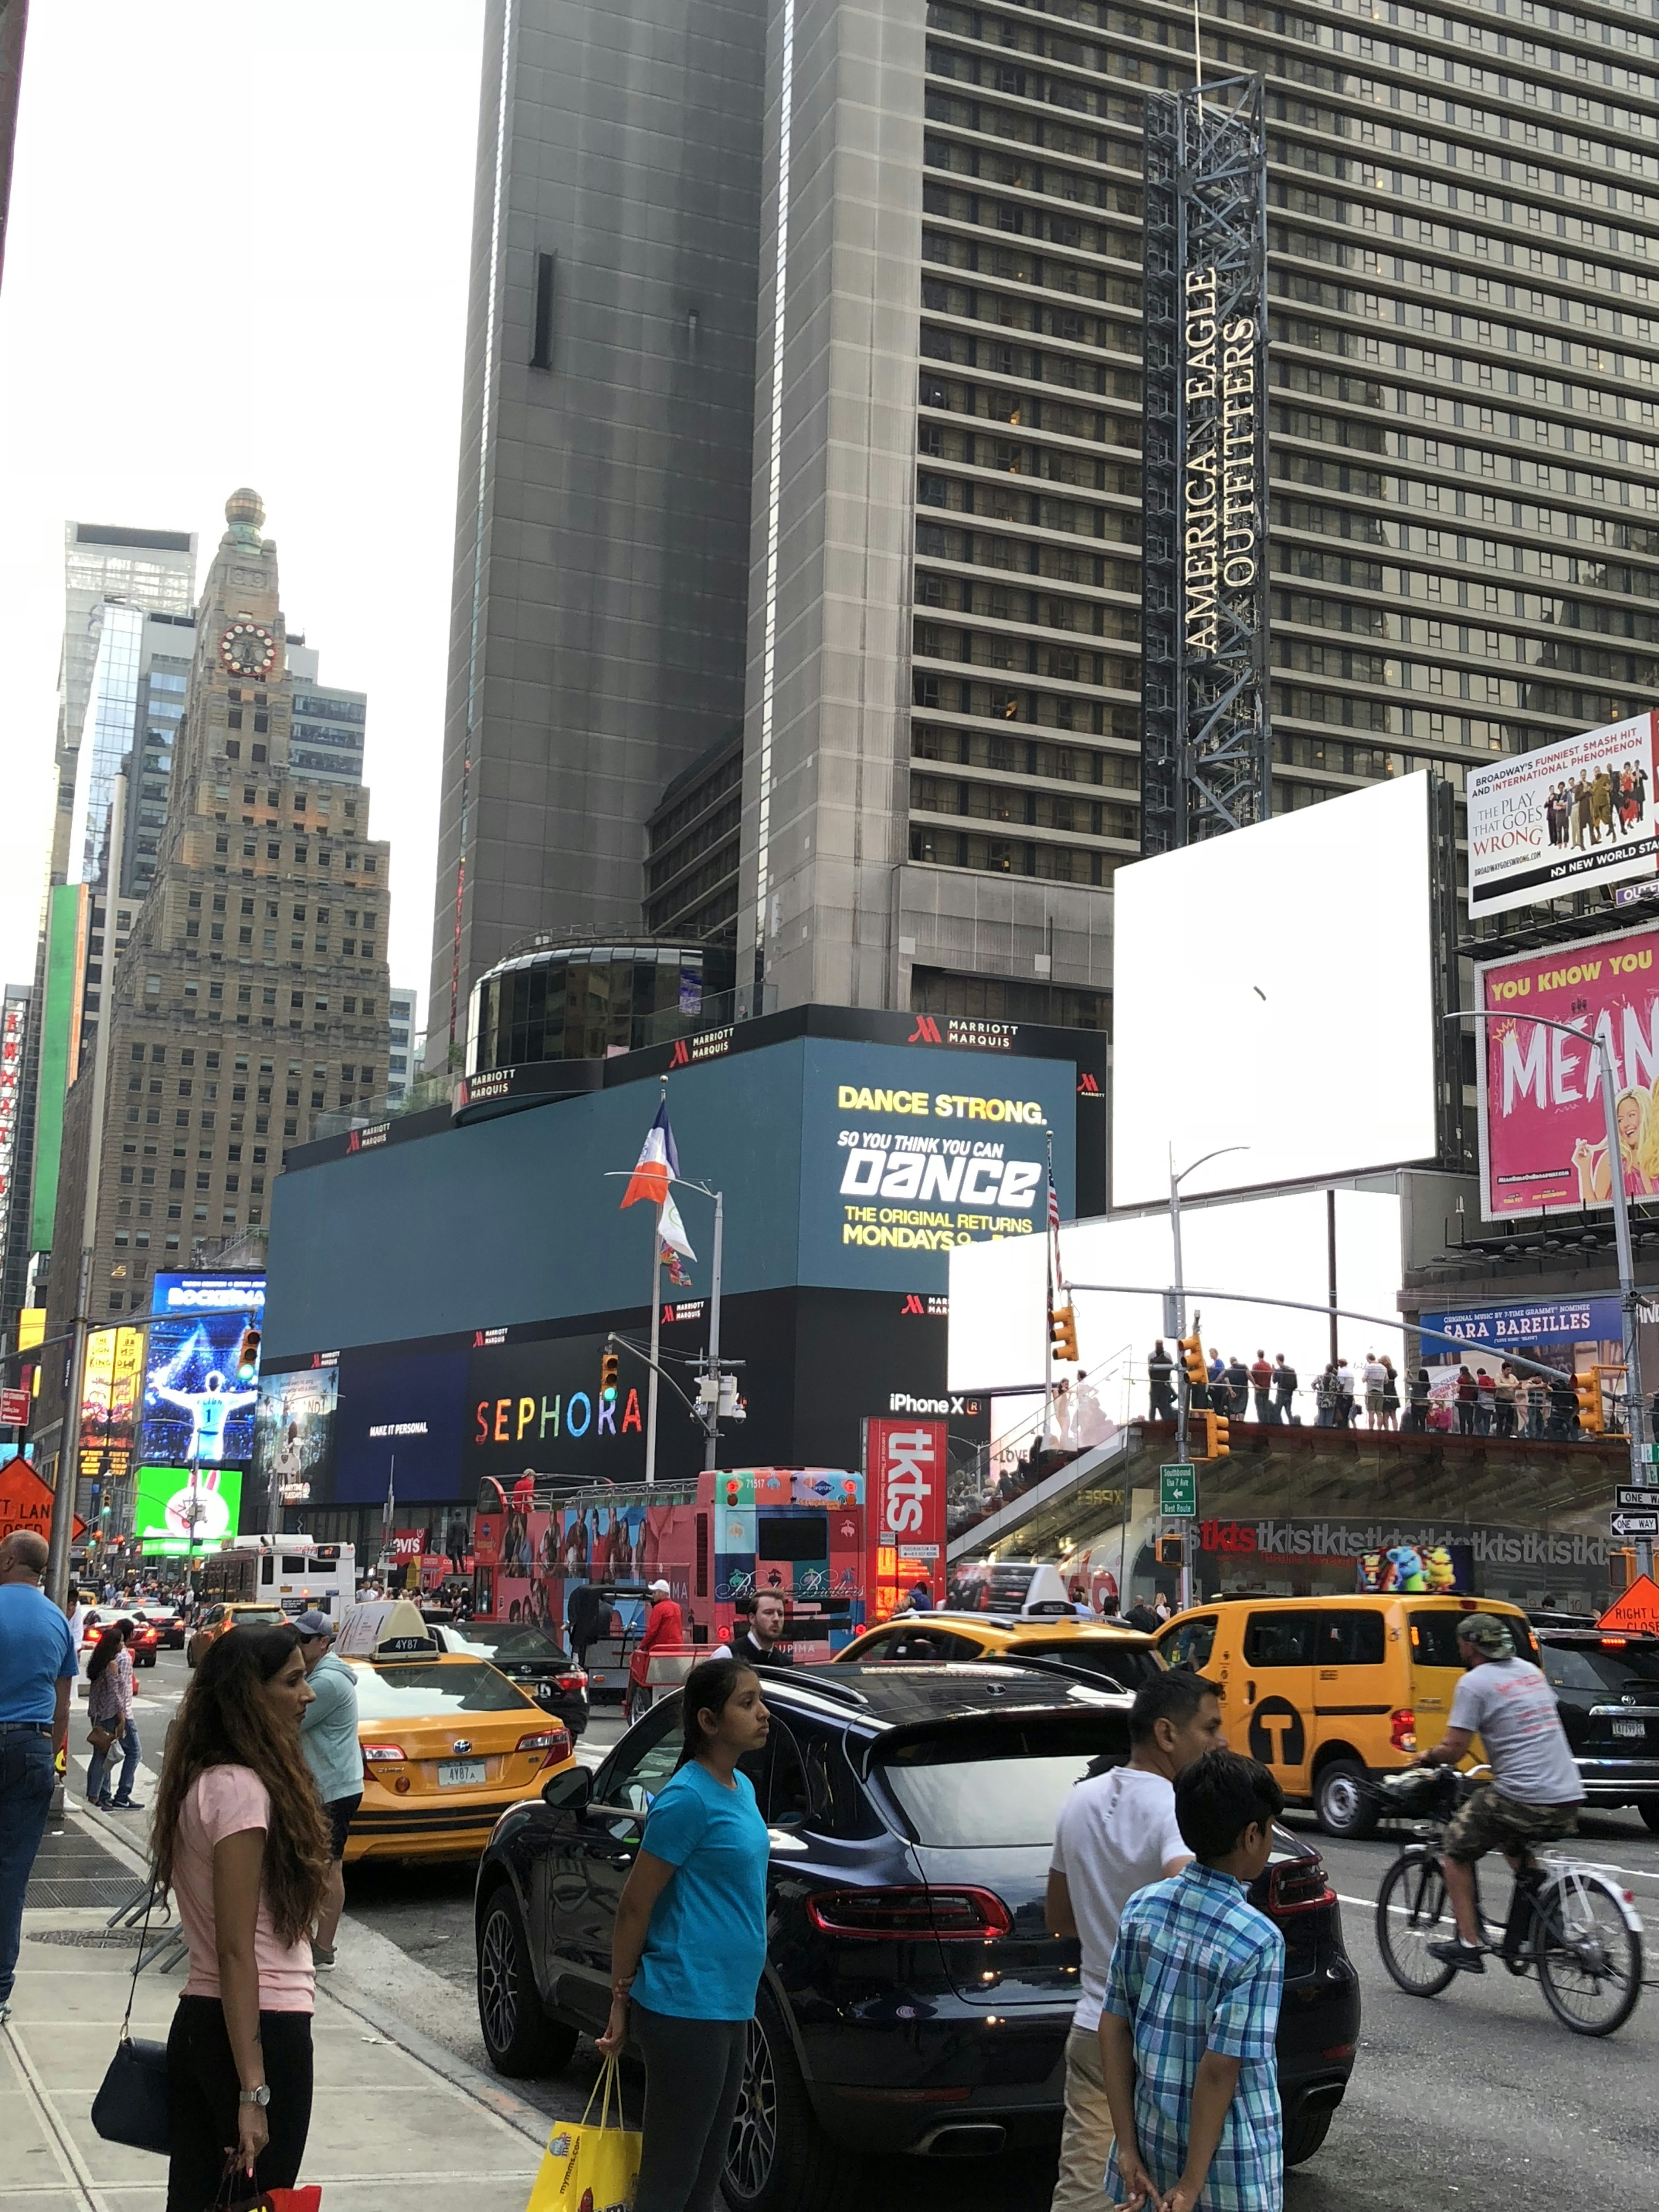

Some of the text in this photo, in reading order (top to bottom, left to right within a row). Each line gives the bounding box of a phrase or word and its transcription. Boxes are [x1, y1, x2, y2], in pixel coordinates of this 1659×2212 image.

[1184, 267, 1217, 653] AMERICAN EAGLE
[1224, 318, 1255, 588] OUTFITTERS
[1475, 727, 1637, 786] BROADWAY'S FUNNIEST SMASH HIT
[1472, 737, 1643, 798] AND INTERNATIONAL PHENOMENON
[1478, 790, 1535, 821] THE PLAY
[1473, 804, 1543, 836] THAT GOES
[1472, 826, 1543, 857] WRONG
[1569, 859, 1593, 873] NEW
[1596, 849, 1636, 867] WORLD
[1491, 950, 1653, 1001] YOU KNOW YOU
[693, 1027, 734, 1047] MARRIOTT
[950, 1020, 1018, 1034] MARRIOTT
[692, 1041, 728, 1059] MARQUIS
[950, 1034, 1010, 1047] MARQUIS
[1502, 997, 1659, 1118] MEAN
[471, 1068, 516, 1086] MARRIOTT
[471, 1083, 509, 1099] MARQUIS
[838, 1086, 1047, 1125] DANCE STRONG.
[362, 1123, 391, 1136] MARRIOTT
[361, 1133, 387, 1147] MARQUIS
[837, 1130, 1004, 1158] SO YOU THINK YOU CAN
[845, 1205, 1033, 1234] THE ORIGINAL RETURNS
[843, 1224, 955, 1251] MONDAYS
[676, 1301, 704, 1311] MARRIOTT
[676, 1309, 701, 1320] MARQUIS
[1443, 1316, 1473, 1324] ORIGINAL
[1474, 1313, 1494, 1321] MUSIC
[1504, 1309, 1524, 1318] 7-TIME
[1560, 1304, 1591, 1312] NOMINEE
[485, 1328, 508, 1336] MARRIOTT
[1443, 1313, 1591, 1338] SARA BAREILLES
[484, 1335, 505, 1344] MARQUIS
[890, 1393, 949, 1414] iPhone
[950, 1396, 965, 1415] X
[476, 1388, 642, 1445] SEPHORA
[370, 1422, 428, 1437] MAKE IT PERSONAL
[887, 1429, 934, 1532] tkts
[1164, 1468, 1191, 1477] Southbound
[1180, 1478, 1189, 1486] Ave
[746, 1479, 764, 1488] 71517
[1625, 1493, 1643, 1502] ONE
[1165, 1503, 1191, 1513] Best Route
[1617, 1519, 1654, 1528] ONE WAY
[1201, 1518, 1255, 1551] tkts
[1570, 1599, 1582, 1611] 10
[1616, 1608, 1646, 1619] RIGHT
[395, 1639, 418, 1649] 4Y87
[1261, 1714, 1292, 1764] T
[560, 2136, 580, 2193] mymms.com
